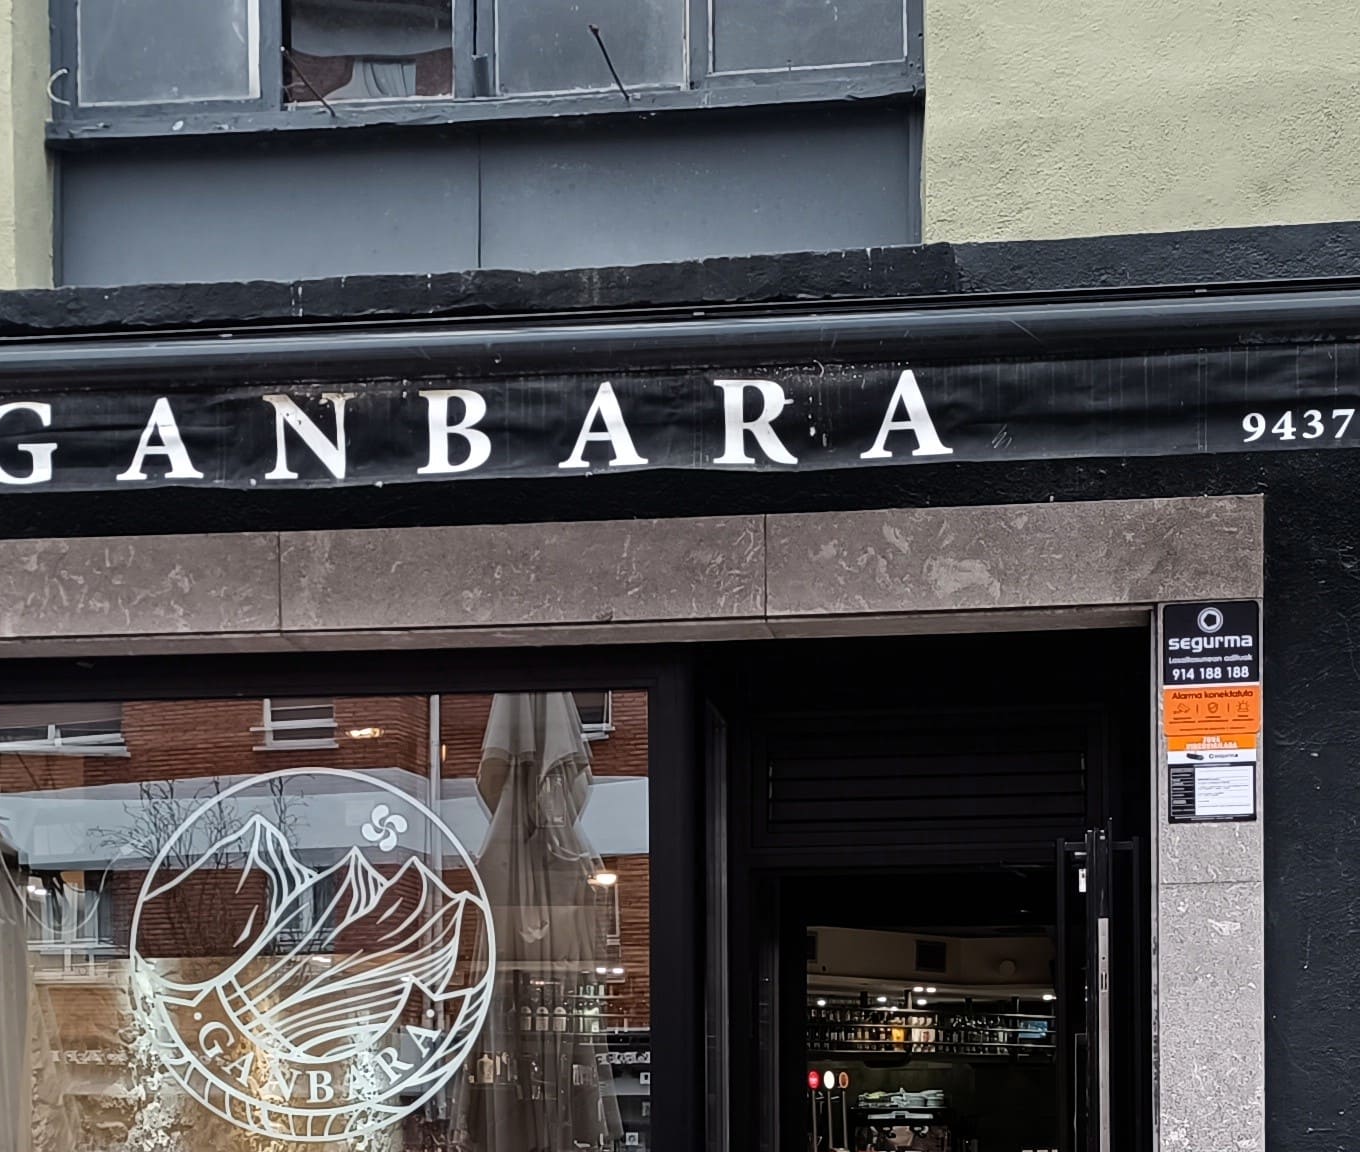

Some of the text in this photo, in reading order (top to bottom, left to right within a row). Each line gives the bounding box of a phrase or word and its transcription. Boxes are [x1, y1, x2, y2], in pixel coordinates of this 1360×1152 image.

[1168, 635, 1253, 653] segurma
[1172, 665, 1249, 680] 914 188 188
[198, 1021, 441, 1104] GANBARA
